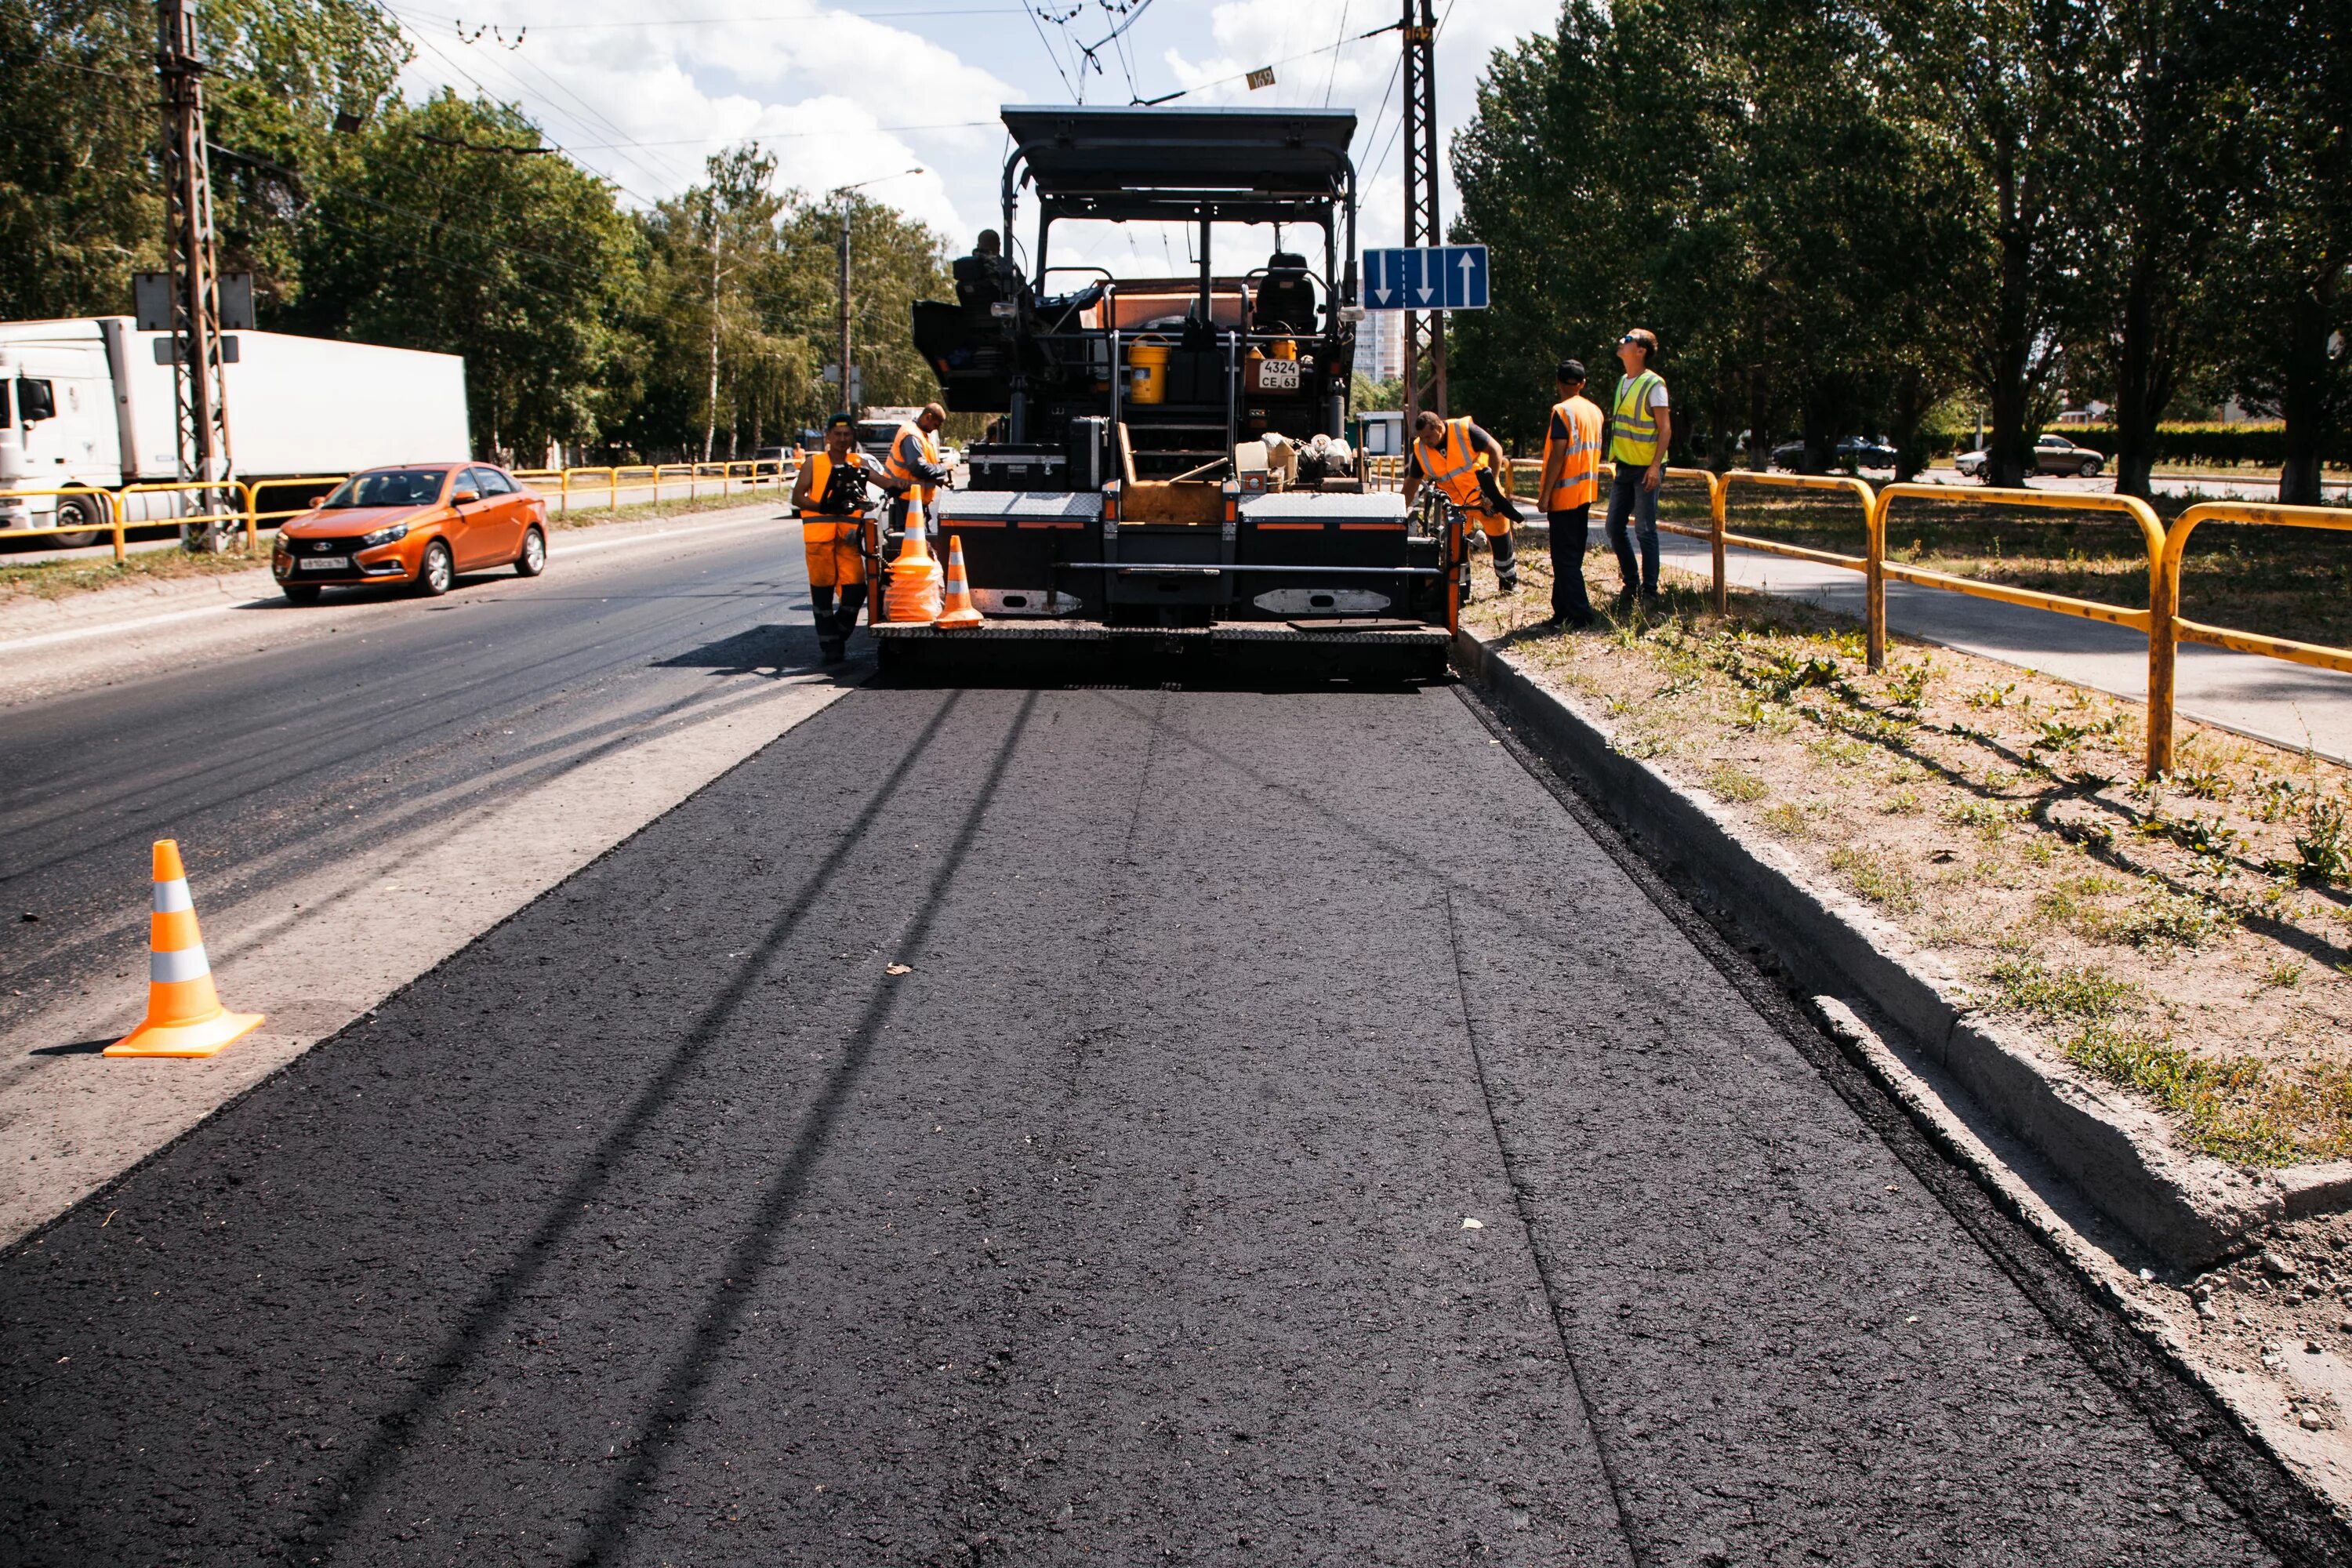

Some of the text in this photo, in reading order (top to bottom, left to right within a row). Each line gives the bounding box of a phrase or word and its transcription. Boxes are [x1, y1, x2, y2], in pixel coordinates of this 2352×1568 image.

[1252, 70, 1272, 87] 169
[1265, 361, 1295, 374] 4324
[1284, 377, 1297, 387] 63
